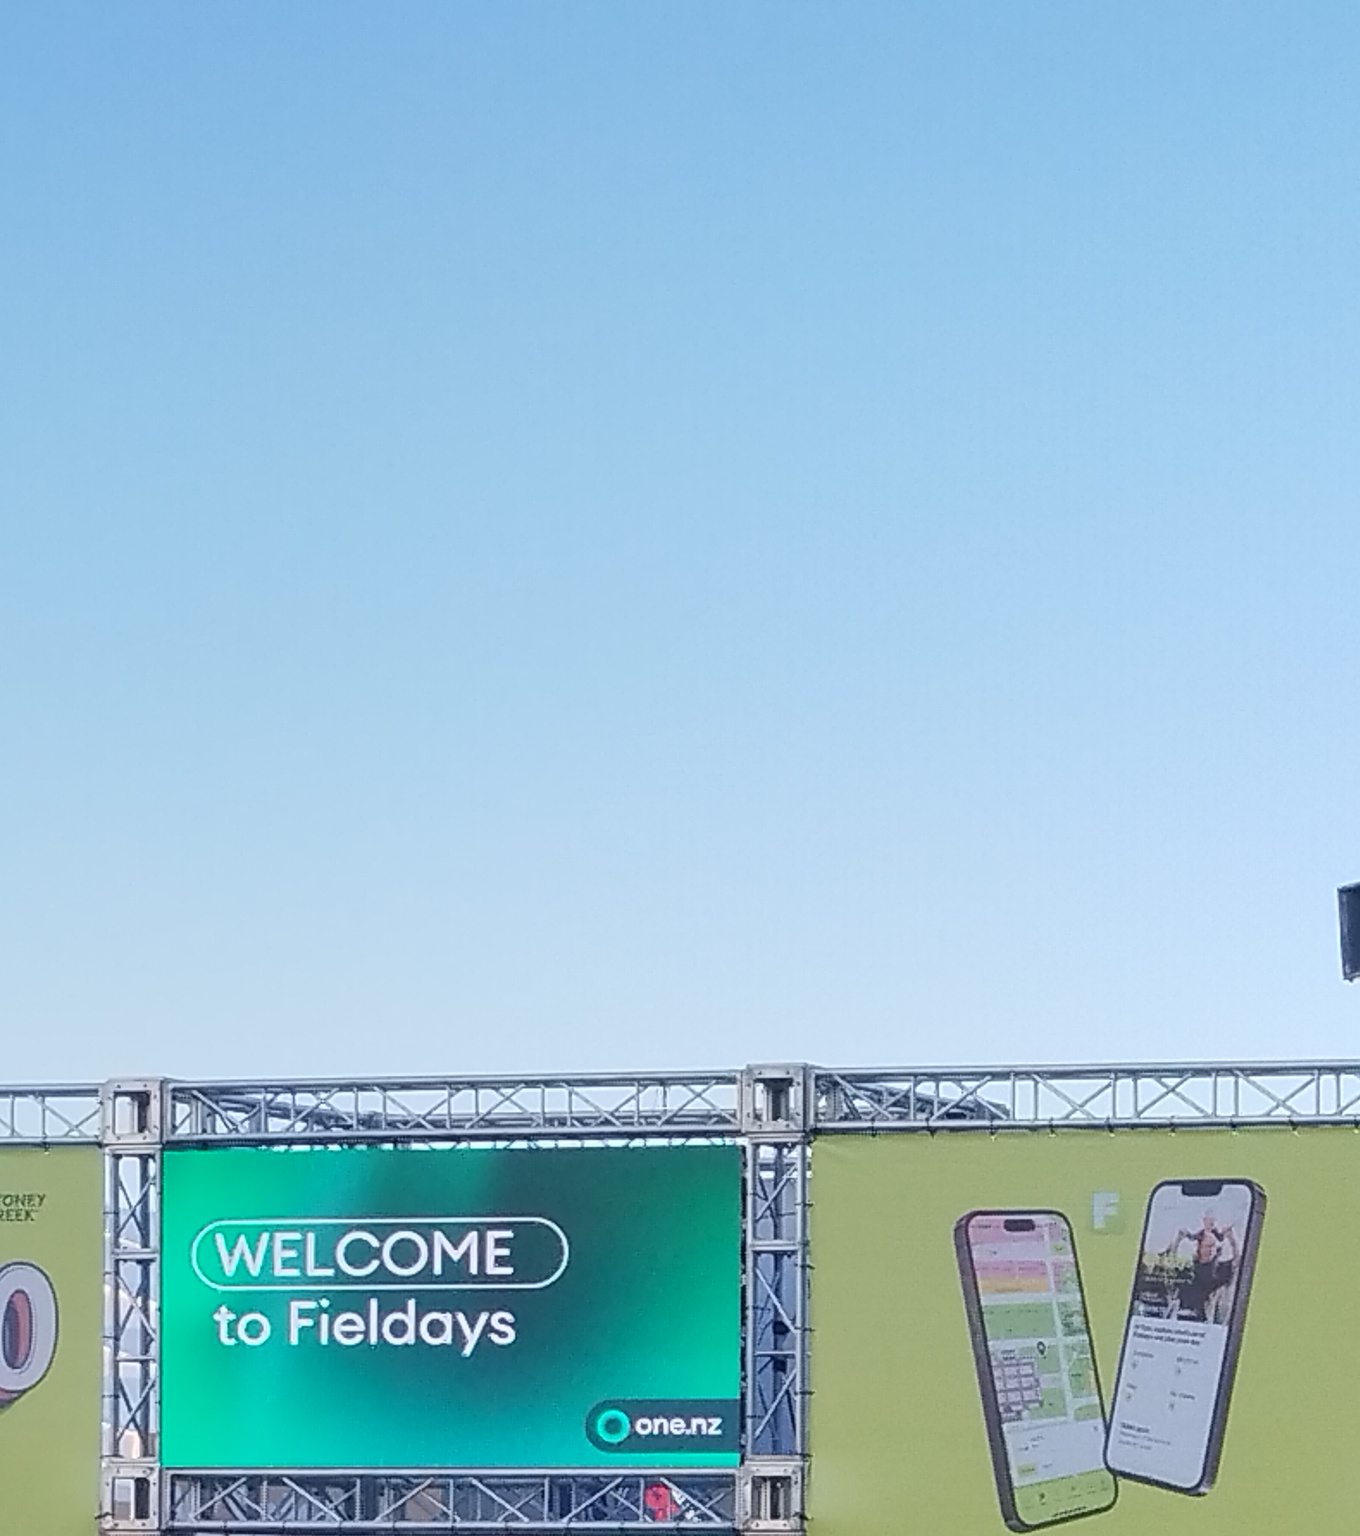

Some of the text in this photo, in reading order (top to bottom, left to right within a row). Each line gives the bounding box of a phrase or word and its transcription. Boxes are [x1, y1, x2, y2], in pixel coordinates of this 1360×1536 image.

[215, 1231, 515, 1278] WELCOME
[214, 1298, 517, 1358] to Fieldays
[635, 1414, 723, 1437] one.nz
